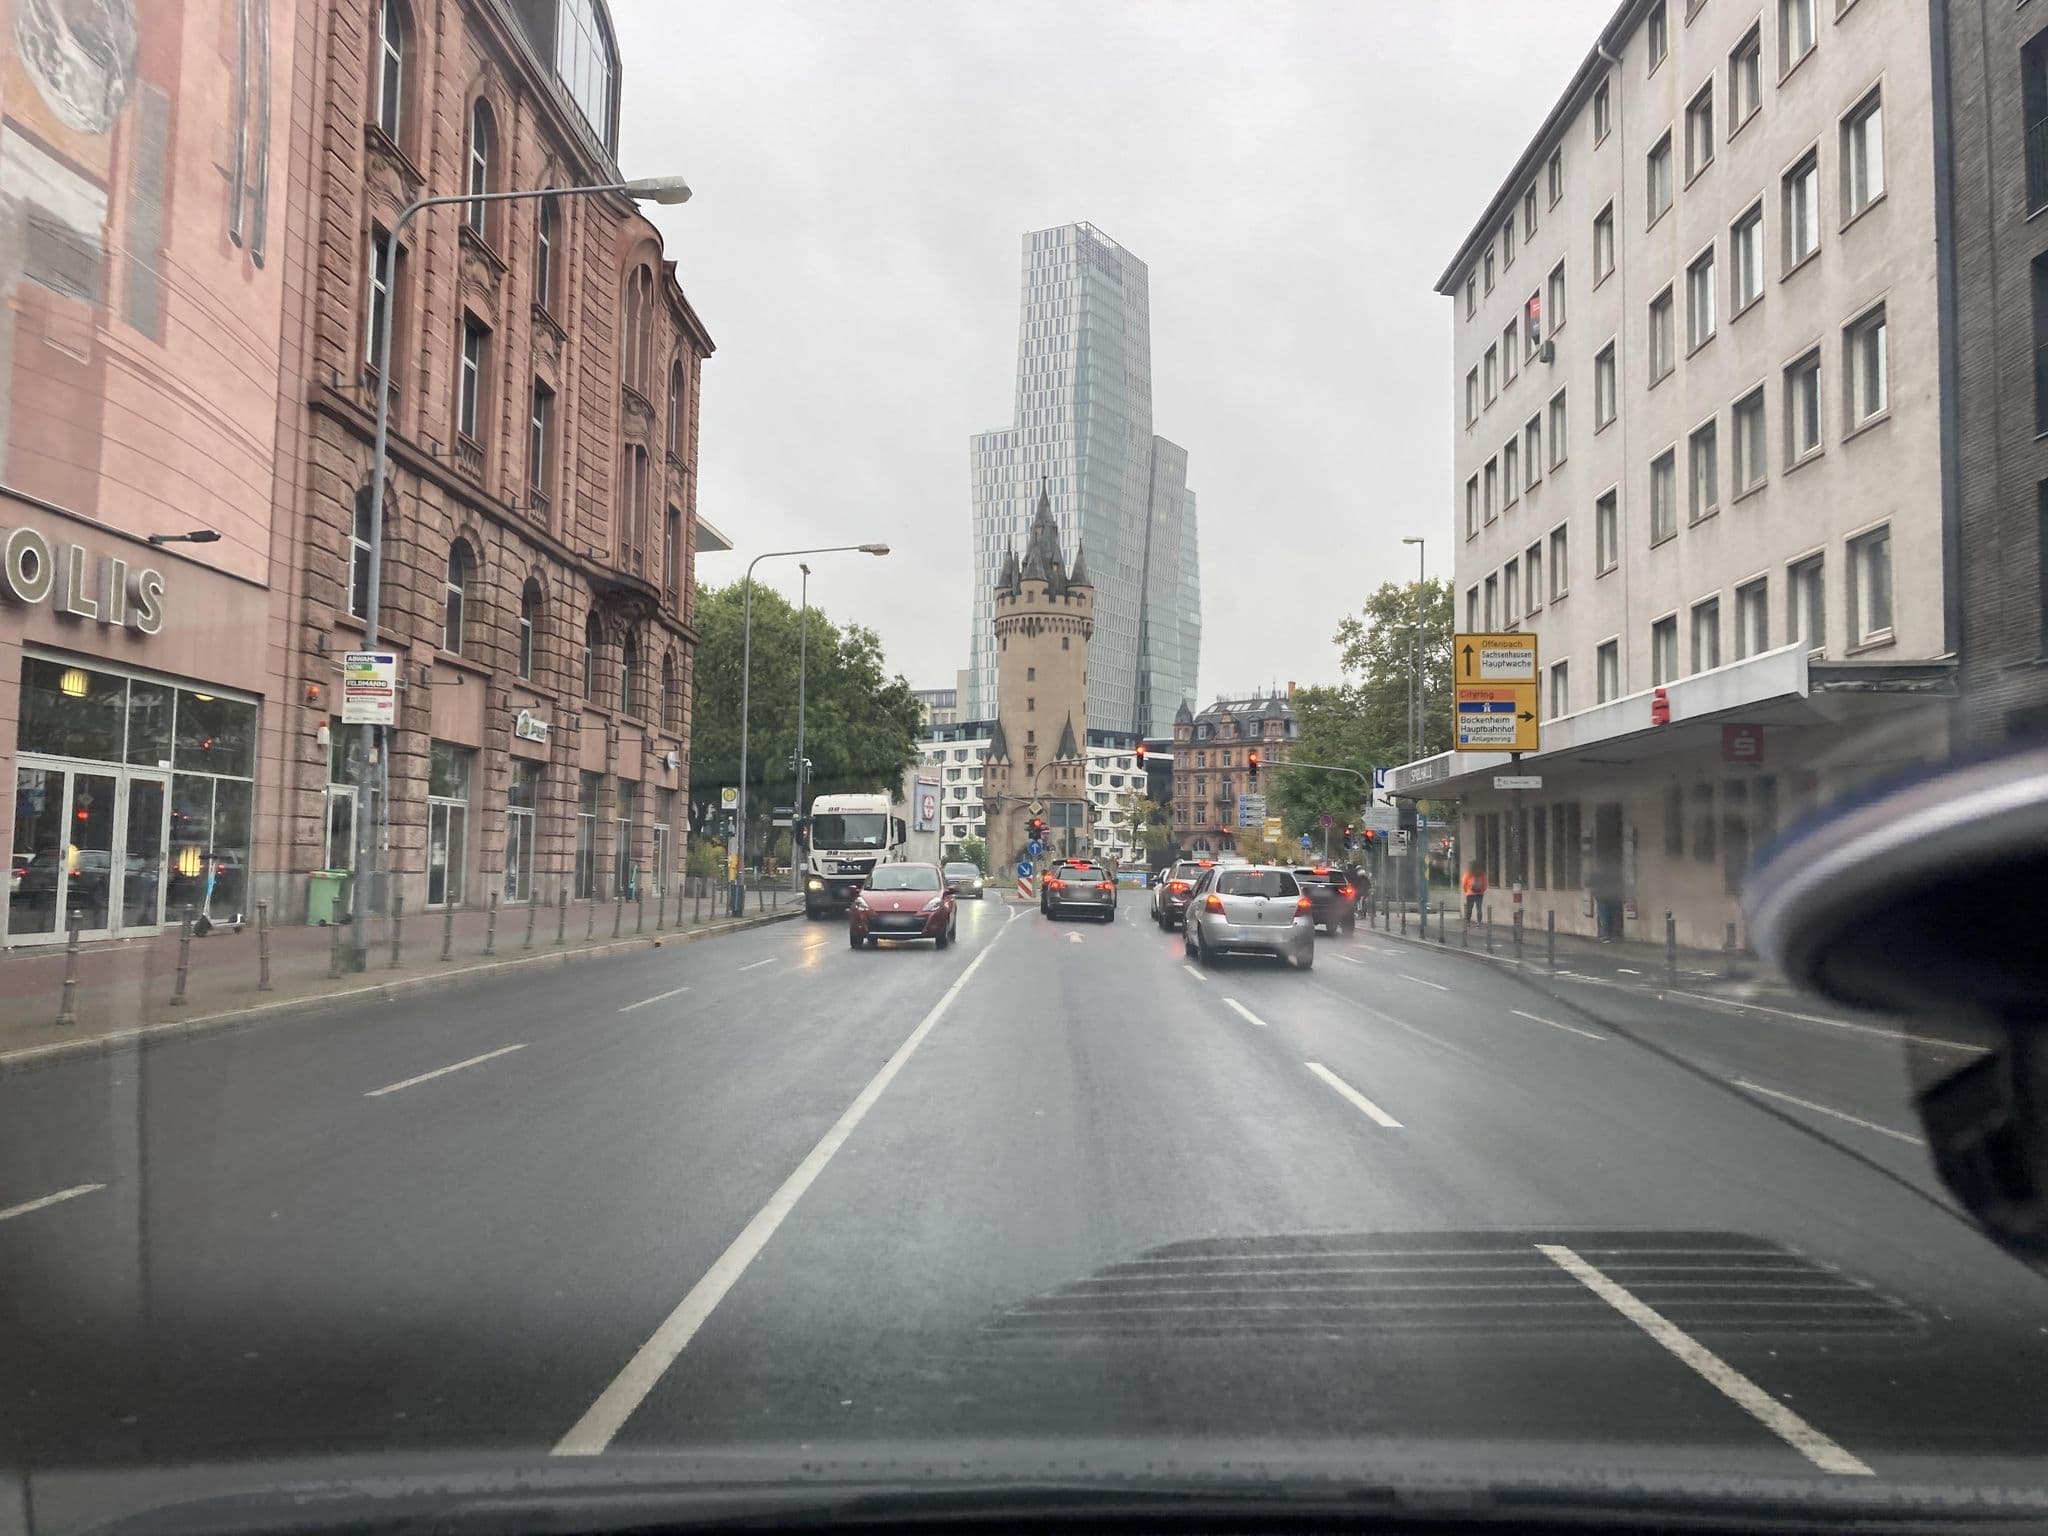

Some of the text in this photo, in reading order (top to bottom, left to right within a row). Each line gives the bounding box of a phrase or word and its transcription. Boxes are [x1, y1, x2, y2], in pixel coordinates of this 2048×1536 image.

[4, 527, 165, 635] OLIS
[1482, 640, 1523, 648] Offenbach
[1482, 651, 1532, 659] Sachsenhausen
[1482, 660, 1532, 668] Hauptwache
[1460, 690, 1494, 700] Cityring
[1460, 716, 1510, 724] Bockenheim
[1460, 725, 1514, 735] Hauptbahnhof
